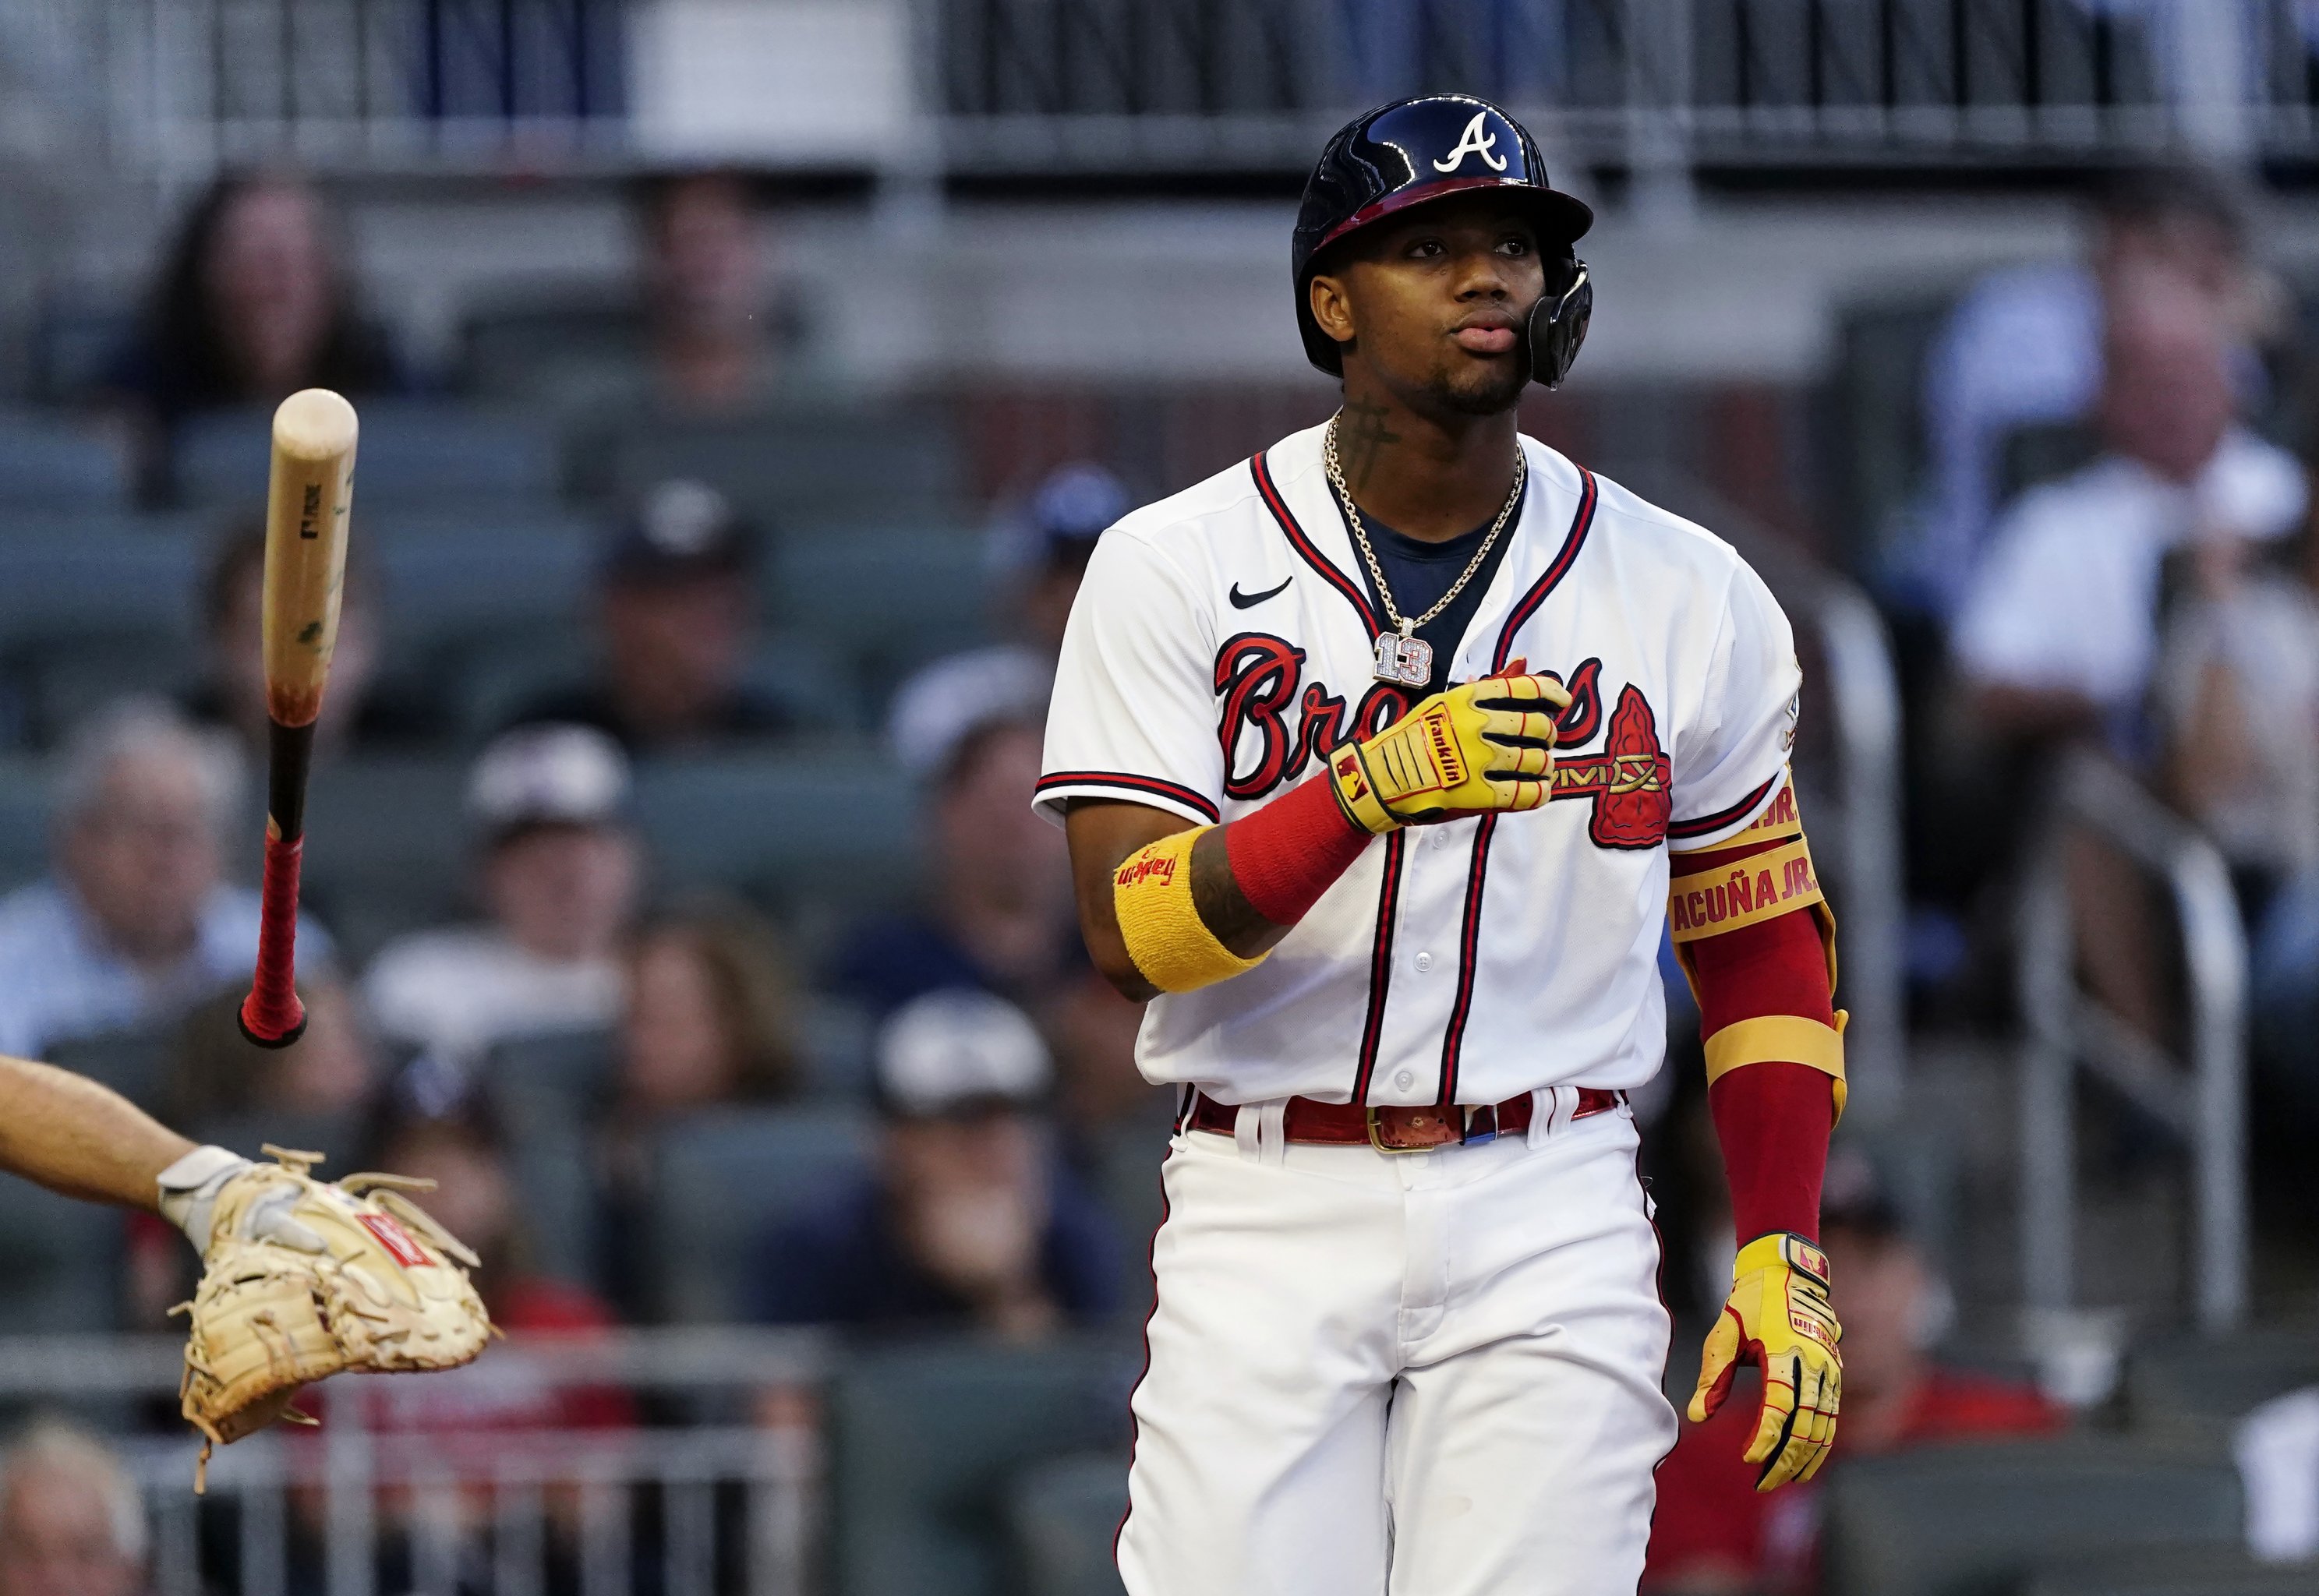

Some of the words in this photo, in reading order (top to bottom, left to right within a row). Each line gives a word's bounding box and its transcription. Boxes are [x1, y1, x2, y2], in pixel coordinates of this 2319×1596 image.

[1433, 111, 1507, 172] A
[1373, 631, 1433, 689] 13
[1214, 632, 1602, 800] Bras
[1425, 713, 1460, 781] Franklin
[1674, 869, 1778, 931] ACUÑA
[1782, 856, 1819, 899] JR.
